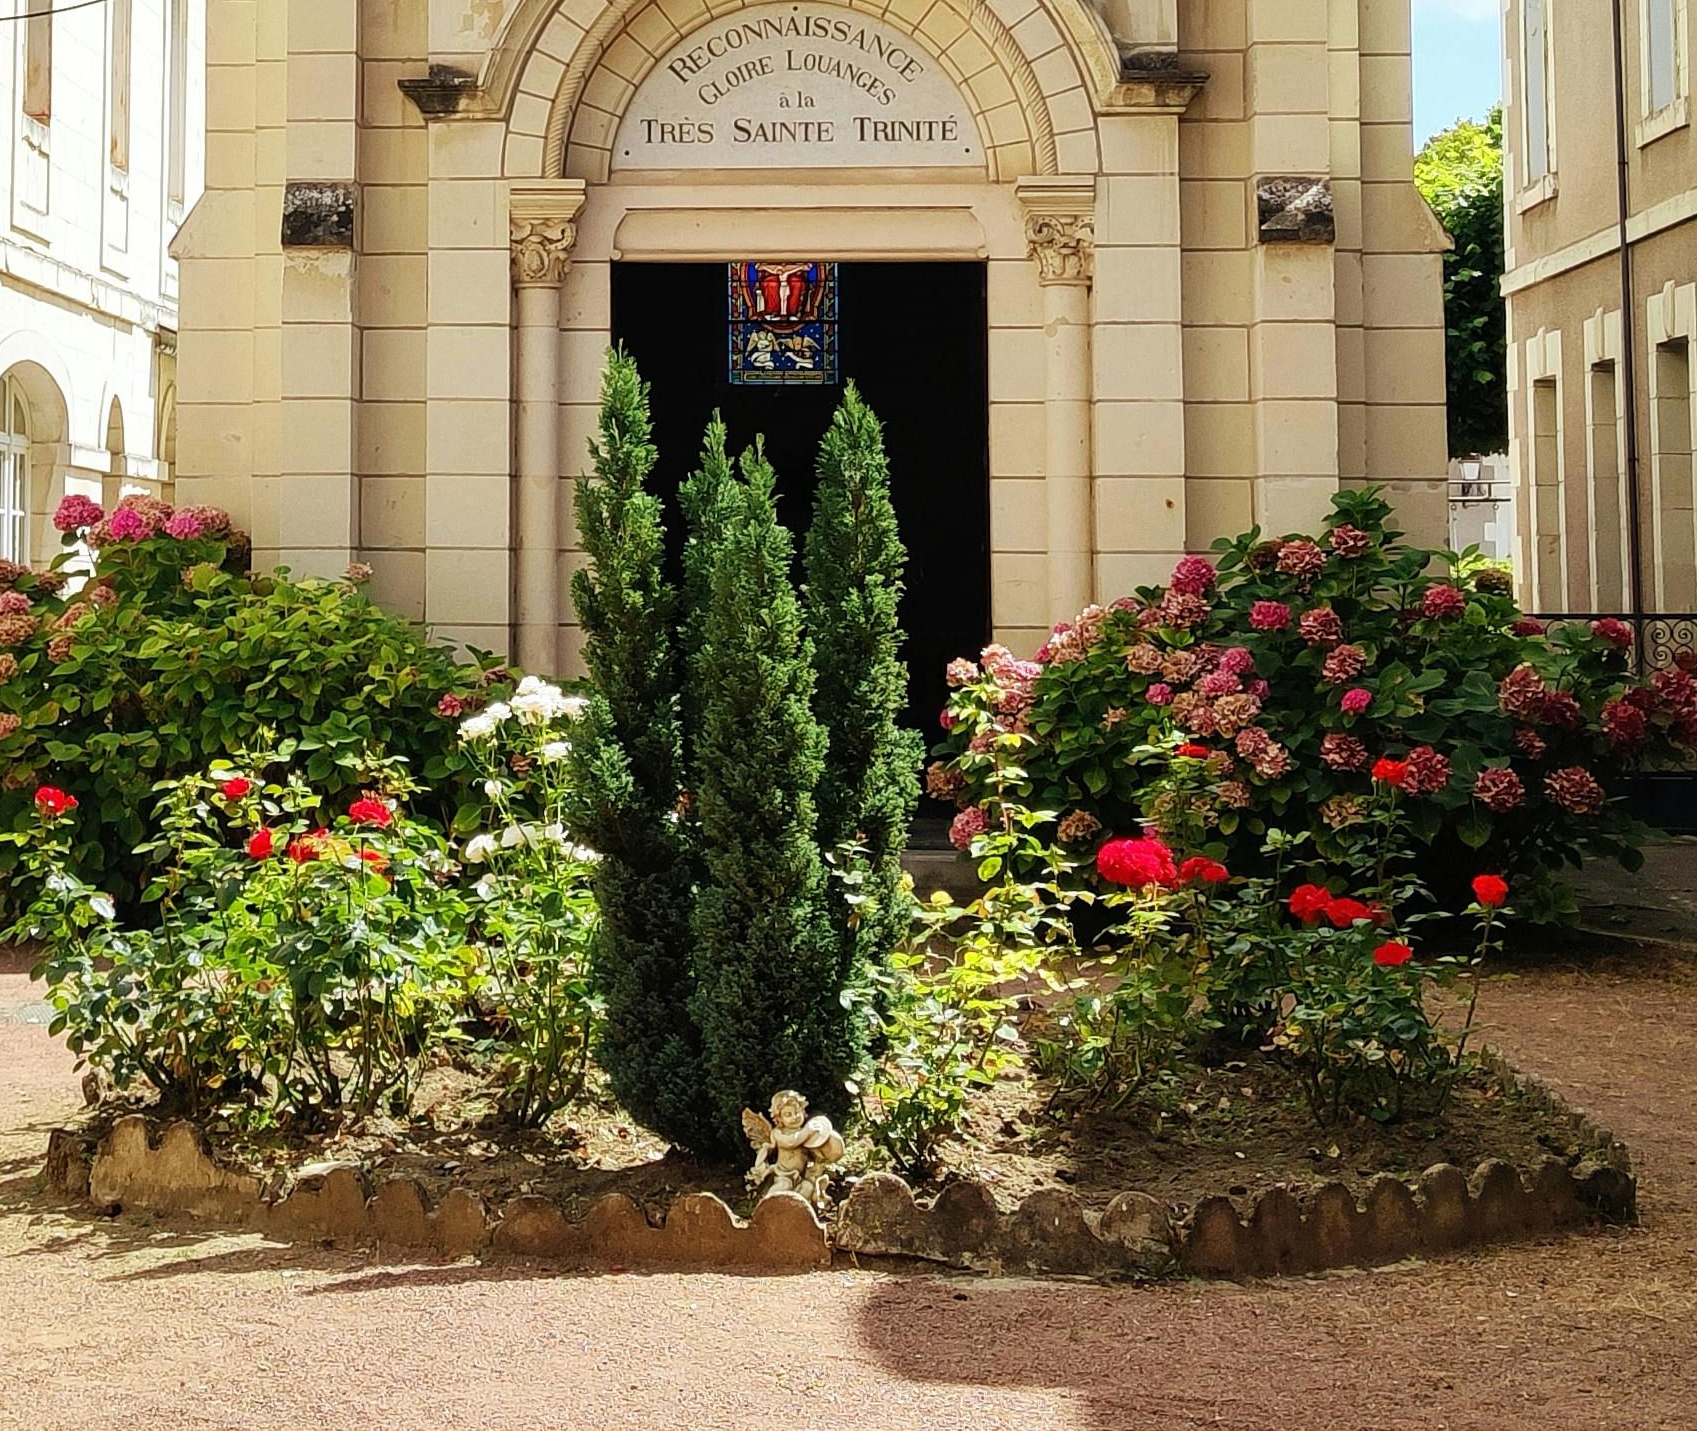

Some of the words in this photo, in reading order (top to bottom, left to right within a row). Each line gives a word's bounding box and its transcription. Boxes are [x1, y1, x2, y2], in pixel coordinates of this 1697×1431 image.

[666, 15, 925, 85] RECONNAISSANCE
[698, 55, 774, 106] GLOIRE
[786, 49, 897, 107] LOUANGES
[797, 90, 816, 108] la
[640, 116, 714, 144] TRÈS
[733, 117, 835, 144] SAINTE
[852, 115, 959, 142] TRINITÉ
